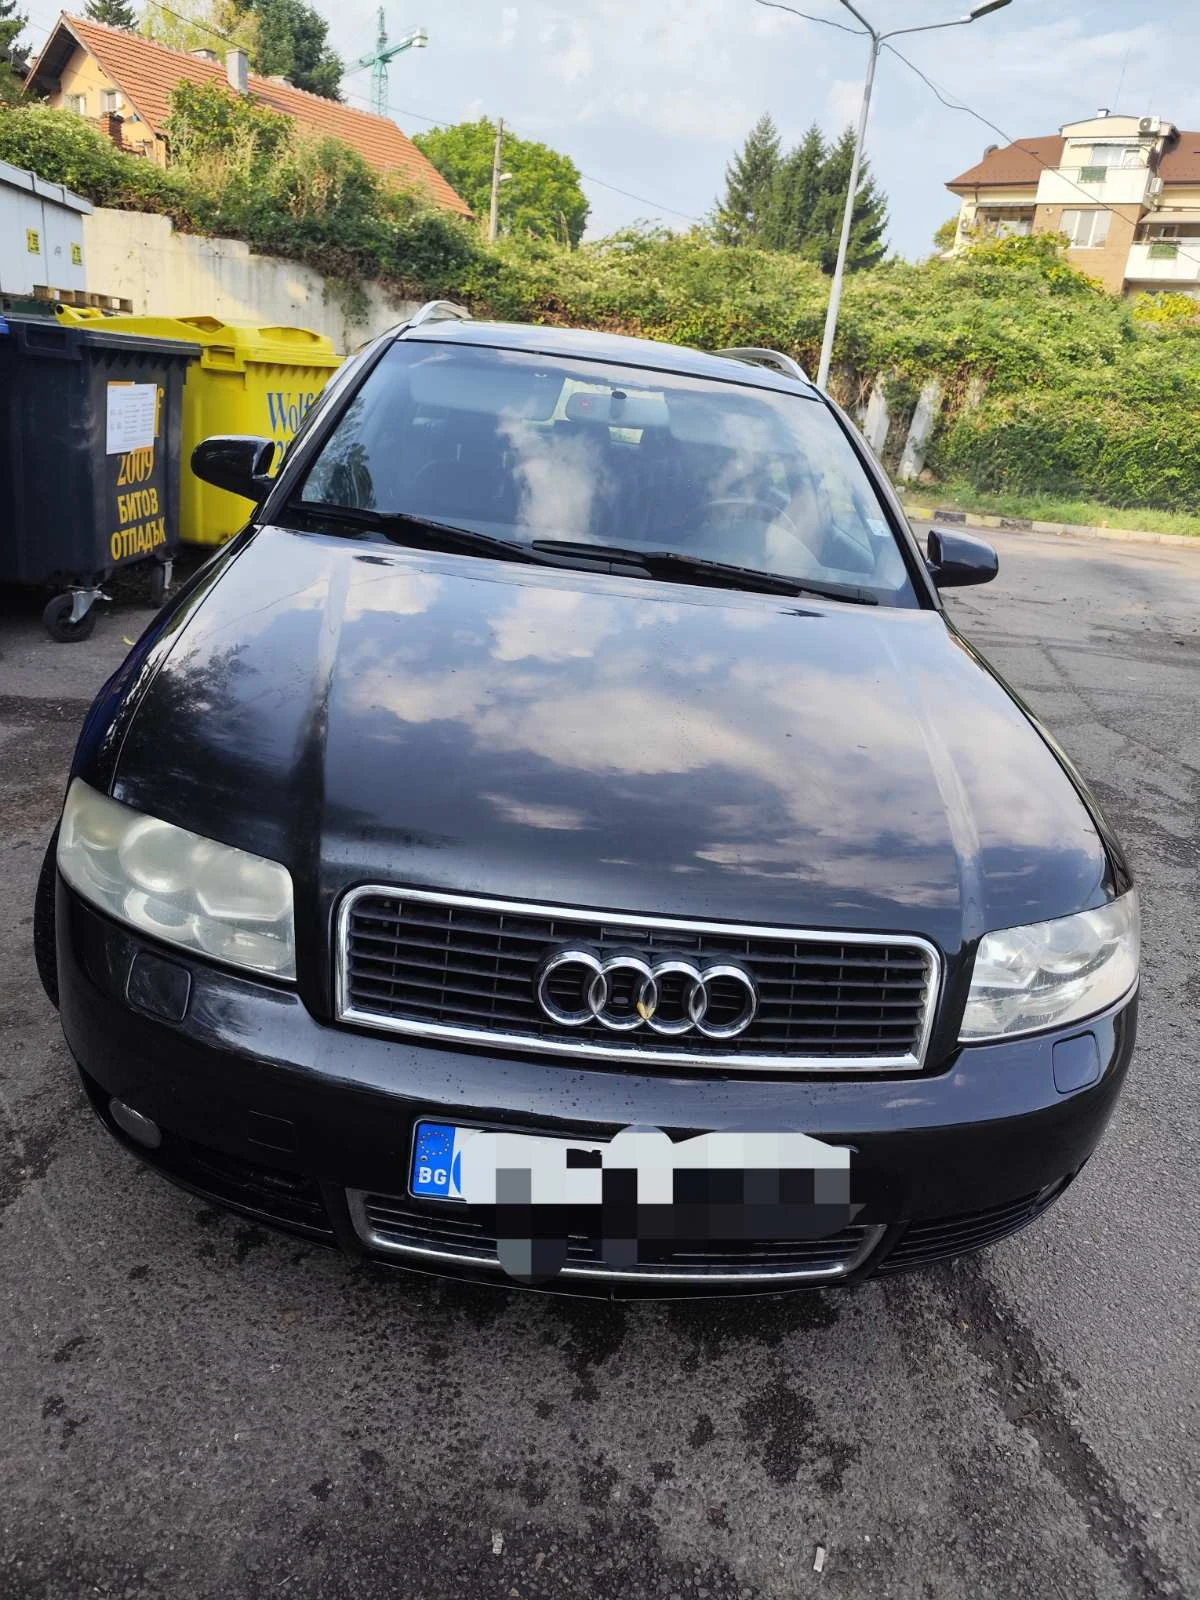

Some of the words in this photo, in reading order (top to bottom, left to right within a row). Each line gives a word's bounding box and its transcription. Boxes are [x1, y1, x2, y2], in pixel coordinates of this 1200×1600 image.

[117, 449, 154, 486] 2009
[117, 487, 159, 524] БИТОВ
[111, 516, 166, 561] ОТПАДЪК
[418, 1166, 447, 1185] BG
